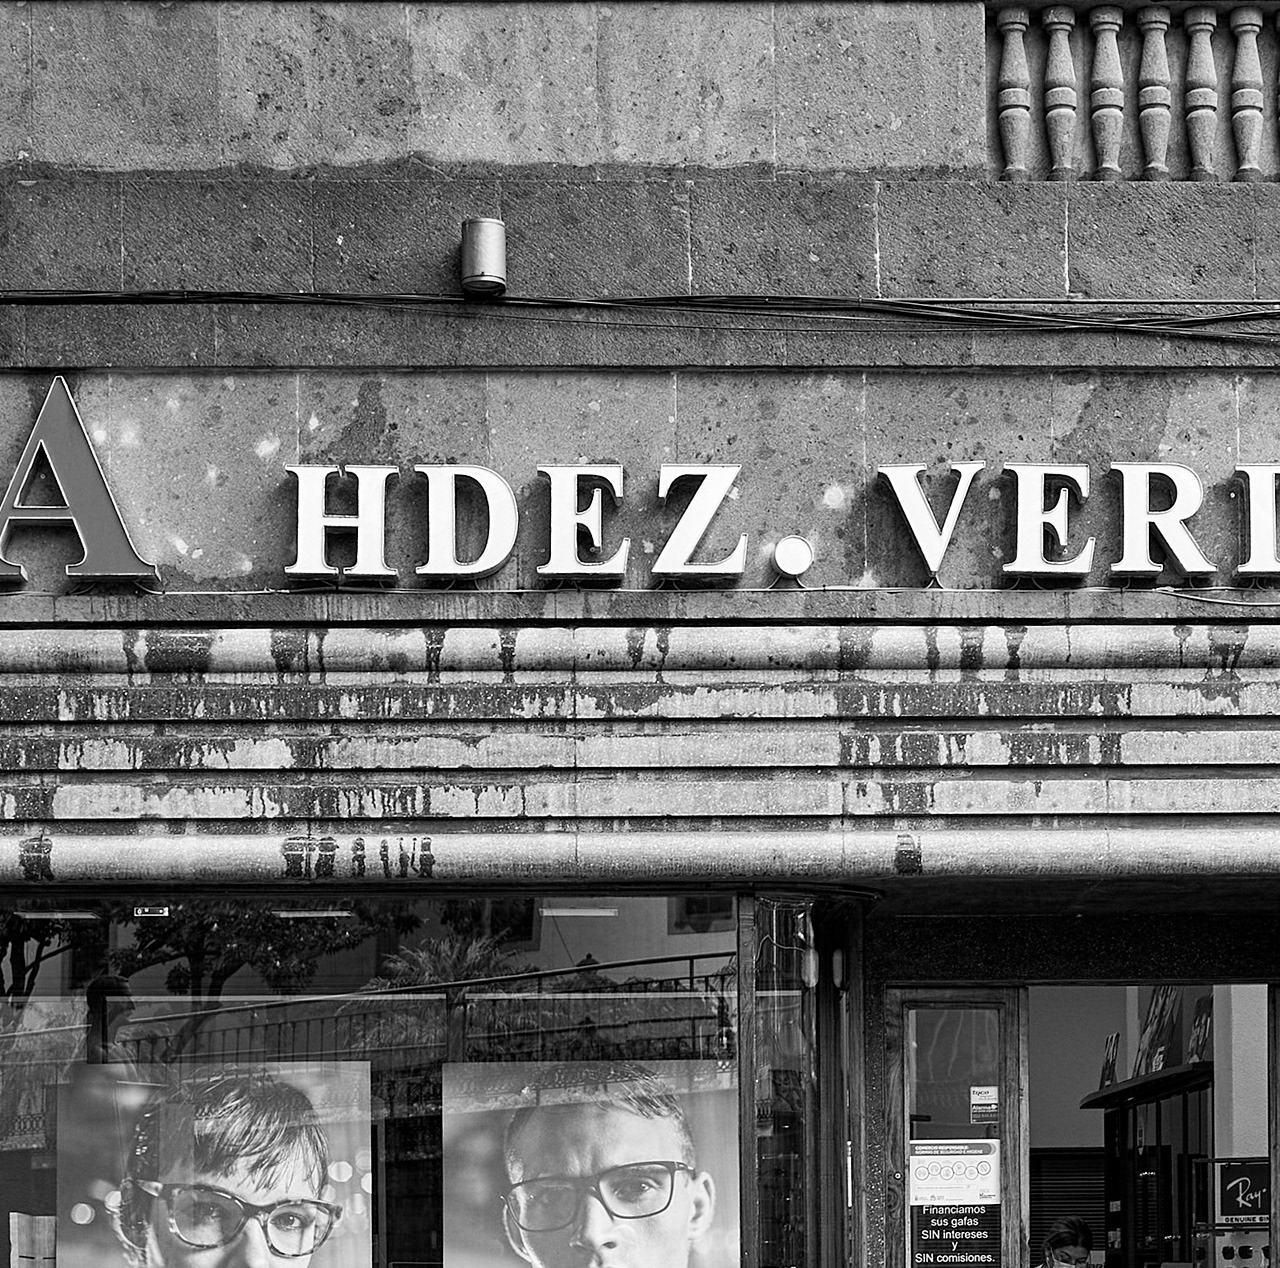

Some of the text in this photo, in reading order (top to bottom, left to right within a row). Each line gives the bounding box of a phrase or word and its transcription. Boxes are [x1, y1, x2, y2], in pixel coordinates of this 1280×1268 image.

[282, 460, 814, 578] HDEZ.
[922, 1205, 986, 1214] Financiamos
[931, 1216, 979, 1228] sus gafas
[921, 1230, 988, 1239] SIN intereses
[951, 1241, 958, 1251] y
[915, 1252, 996, 1263] SIN comisiones.
